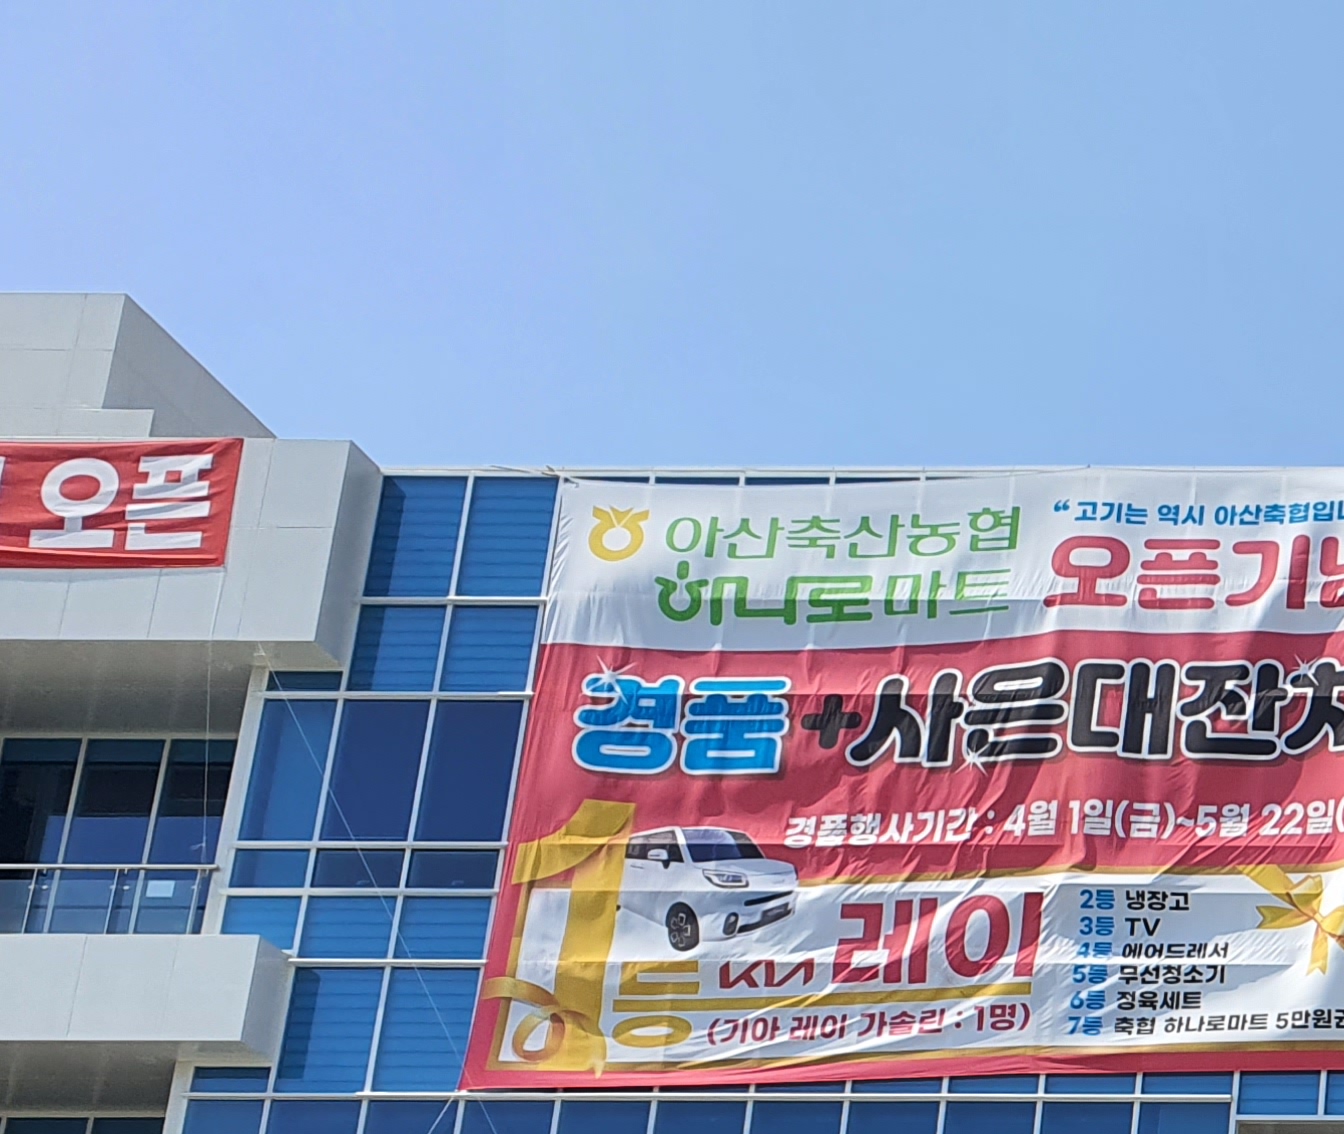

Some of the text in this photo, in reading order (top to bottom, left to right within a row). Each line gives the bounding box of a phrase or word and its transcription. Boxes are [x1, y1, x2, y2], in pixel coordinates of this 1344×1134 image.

[29, 453, 213, 550] 오픈
[1157, 503, 1205, 527] 역시
[665, 506, 1021, 560] 아산축산농협
[653, 560, 1012, 626] 하나로마트
[783, 806, 979, 850] 경품행사기간
[1007, 799, 1058, 838] 4월
[1079, 889, 1190, 912] 2등 냉장고
[1079, 916, 1161, 937] 3등 TV
[832, 892, 1045, 986] 레이
[1076, 941, 1229, 960] 4등 에어드레서
[1072, 963, 1226, 985] 5등 무선청소기
[1070, 989, 1202, 1011] 6등 정육세트
[706, 1016, 780, 1047] (기아
[789, 1014, 847, 1042] 레이
[858, 1007, 944, 1040] 가솔린
[973, 1001, 1031, 1034] 1명)
[1067, 1016, 1104, 1036] 7등
[1114, 1015, 1156, 1036] 축협
[1163, 1012, 1269, 1034] 하나로마트
